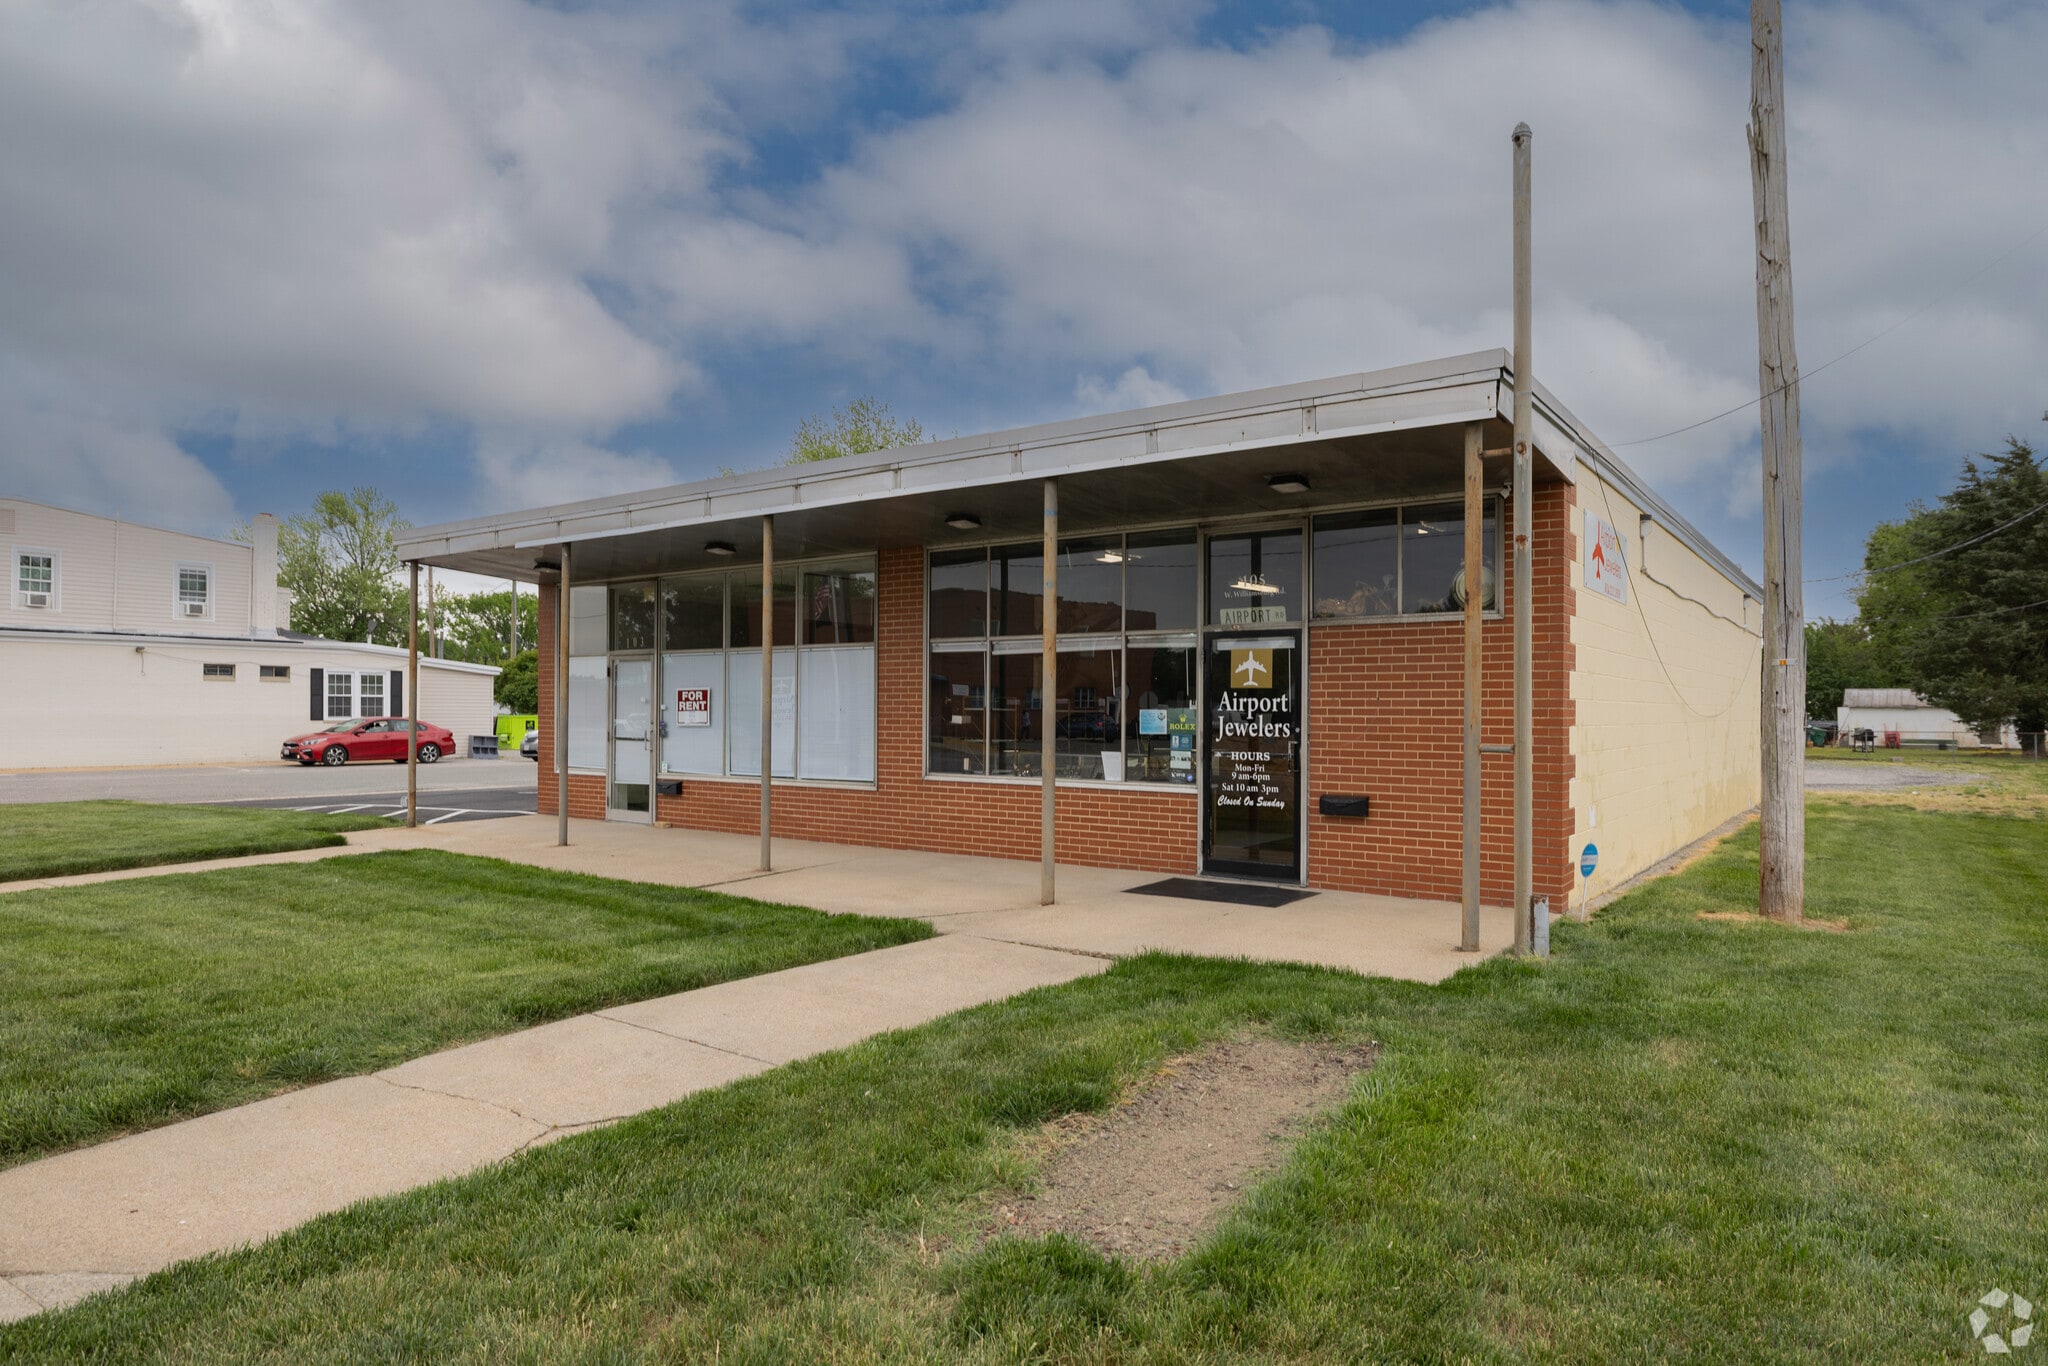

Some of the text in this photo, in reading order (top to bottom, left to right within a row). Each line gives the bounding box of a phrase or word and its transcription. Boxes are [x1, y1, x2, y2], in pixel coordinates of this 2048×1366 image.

[1242, 574, 1266, 587] 105
[1225, 609, 1272, 624] AIRPORT
[682, 691, 703, 701] FOR
[679, 701, 707, 711] RENT
[1217, 691, 1288, 720] Airport
[1169, 723, 1196, 731] ROLEX
[1215, 714, 1291, 742] Jewelers
[1231, 752, 1271, 761] HOURS
[1234, 763, 1265, 772] Mon-Fri
[1221, 783, 1234, 792] Sat
[1236, 783, 1245, 792] 10
[1246, 785, 1259, 793] am
[1217, 795, 1285, 810] Closed On Sunday
